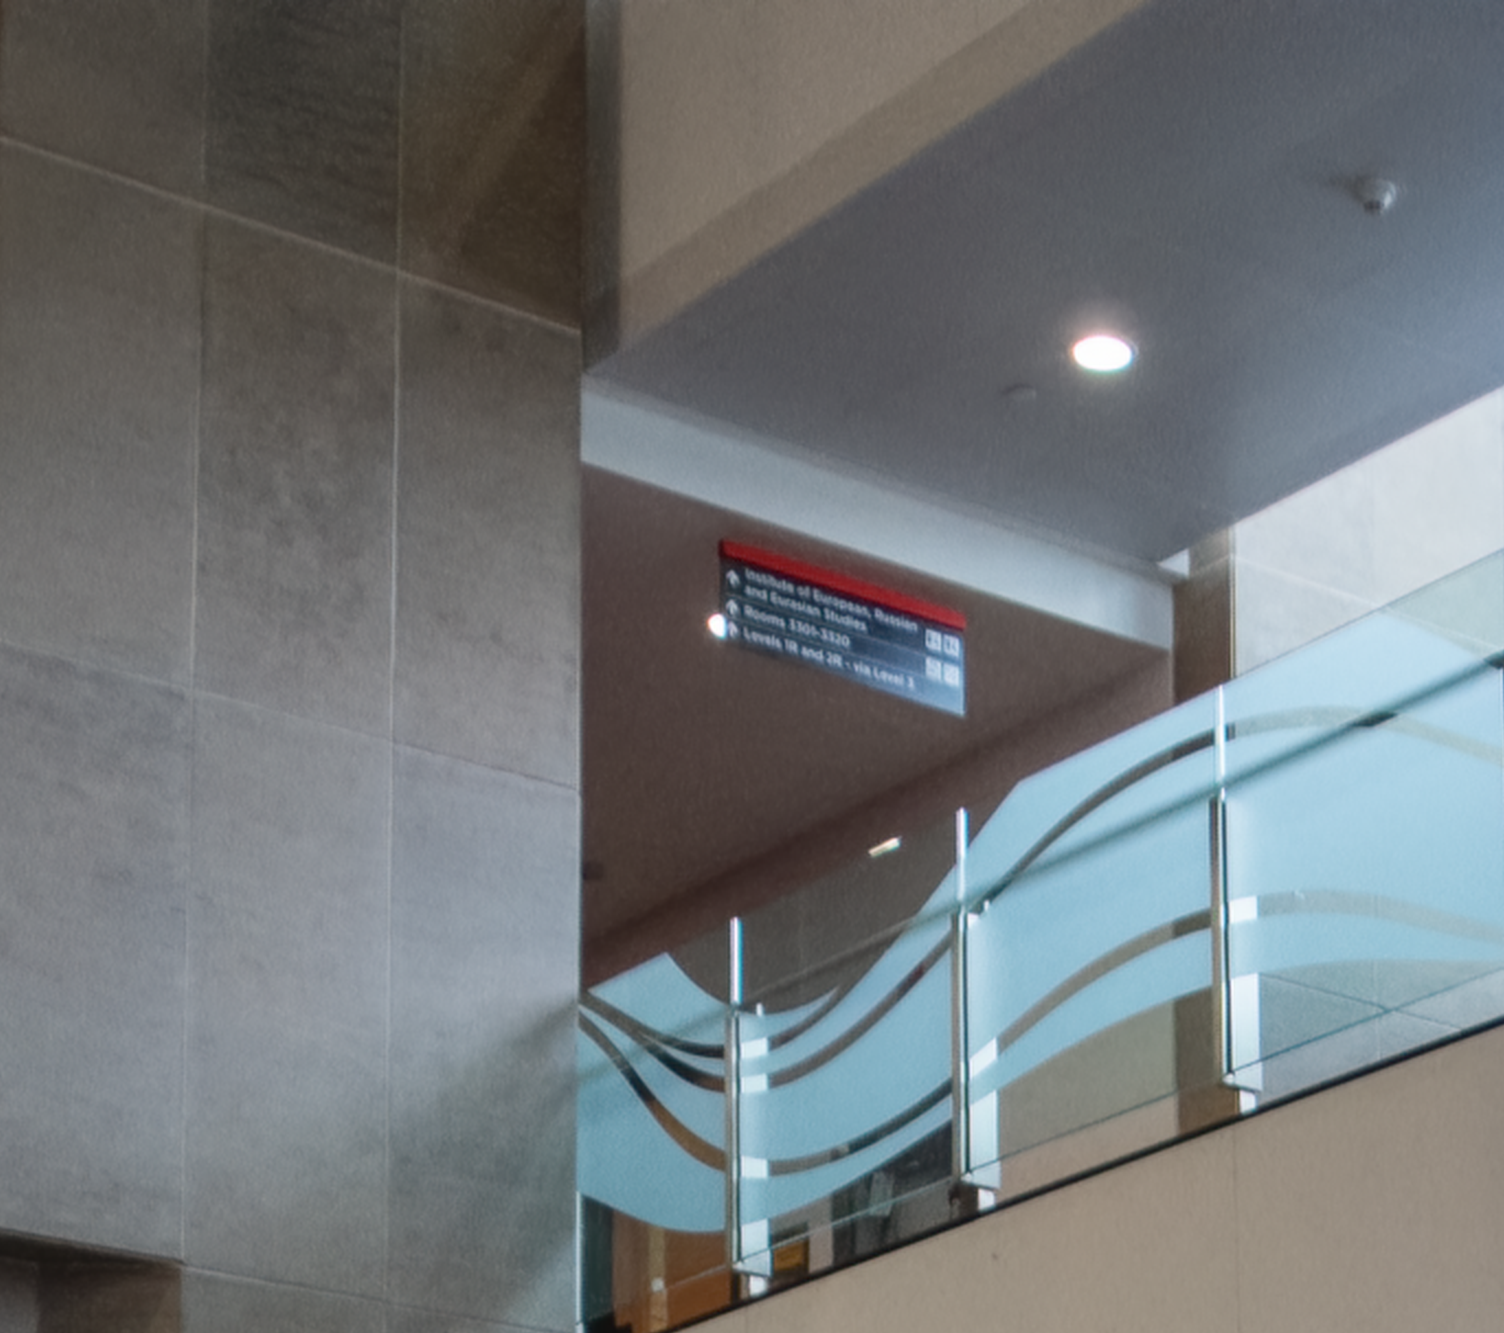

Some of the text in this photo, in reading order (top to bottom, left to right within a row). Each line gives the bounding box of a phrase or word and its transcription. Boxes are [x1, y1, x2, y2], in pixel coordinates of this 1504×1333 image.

[745, 585, 768, 600] and
[797, 585, 810, 598] of
[744, 604, 786, 629] Rooms
[743, 626, 782, 649] Levels
[801, 646, 824, 662] and
[853, 661, 871, 677] via
[873, 666, 904, 686] Level
